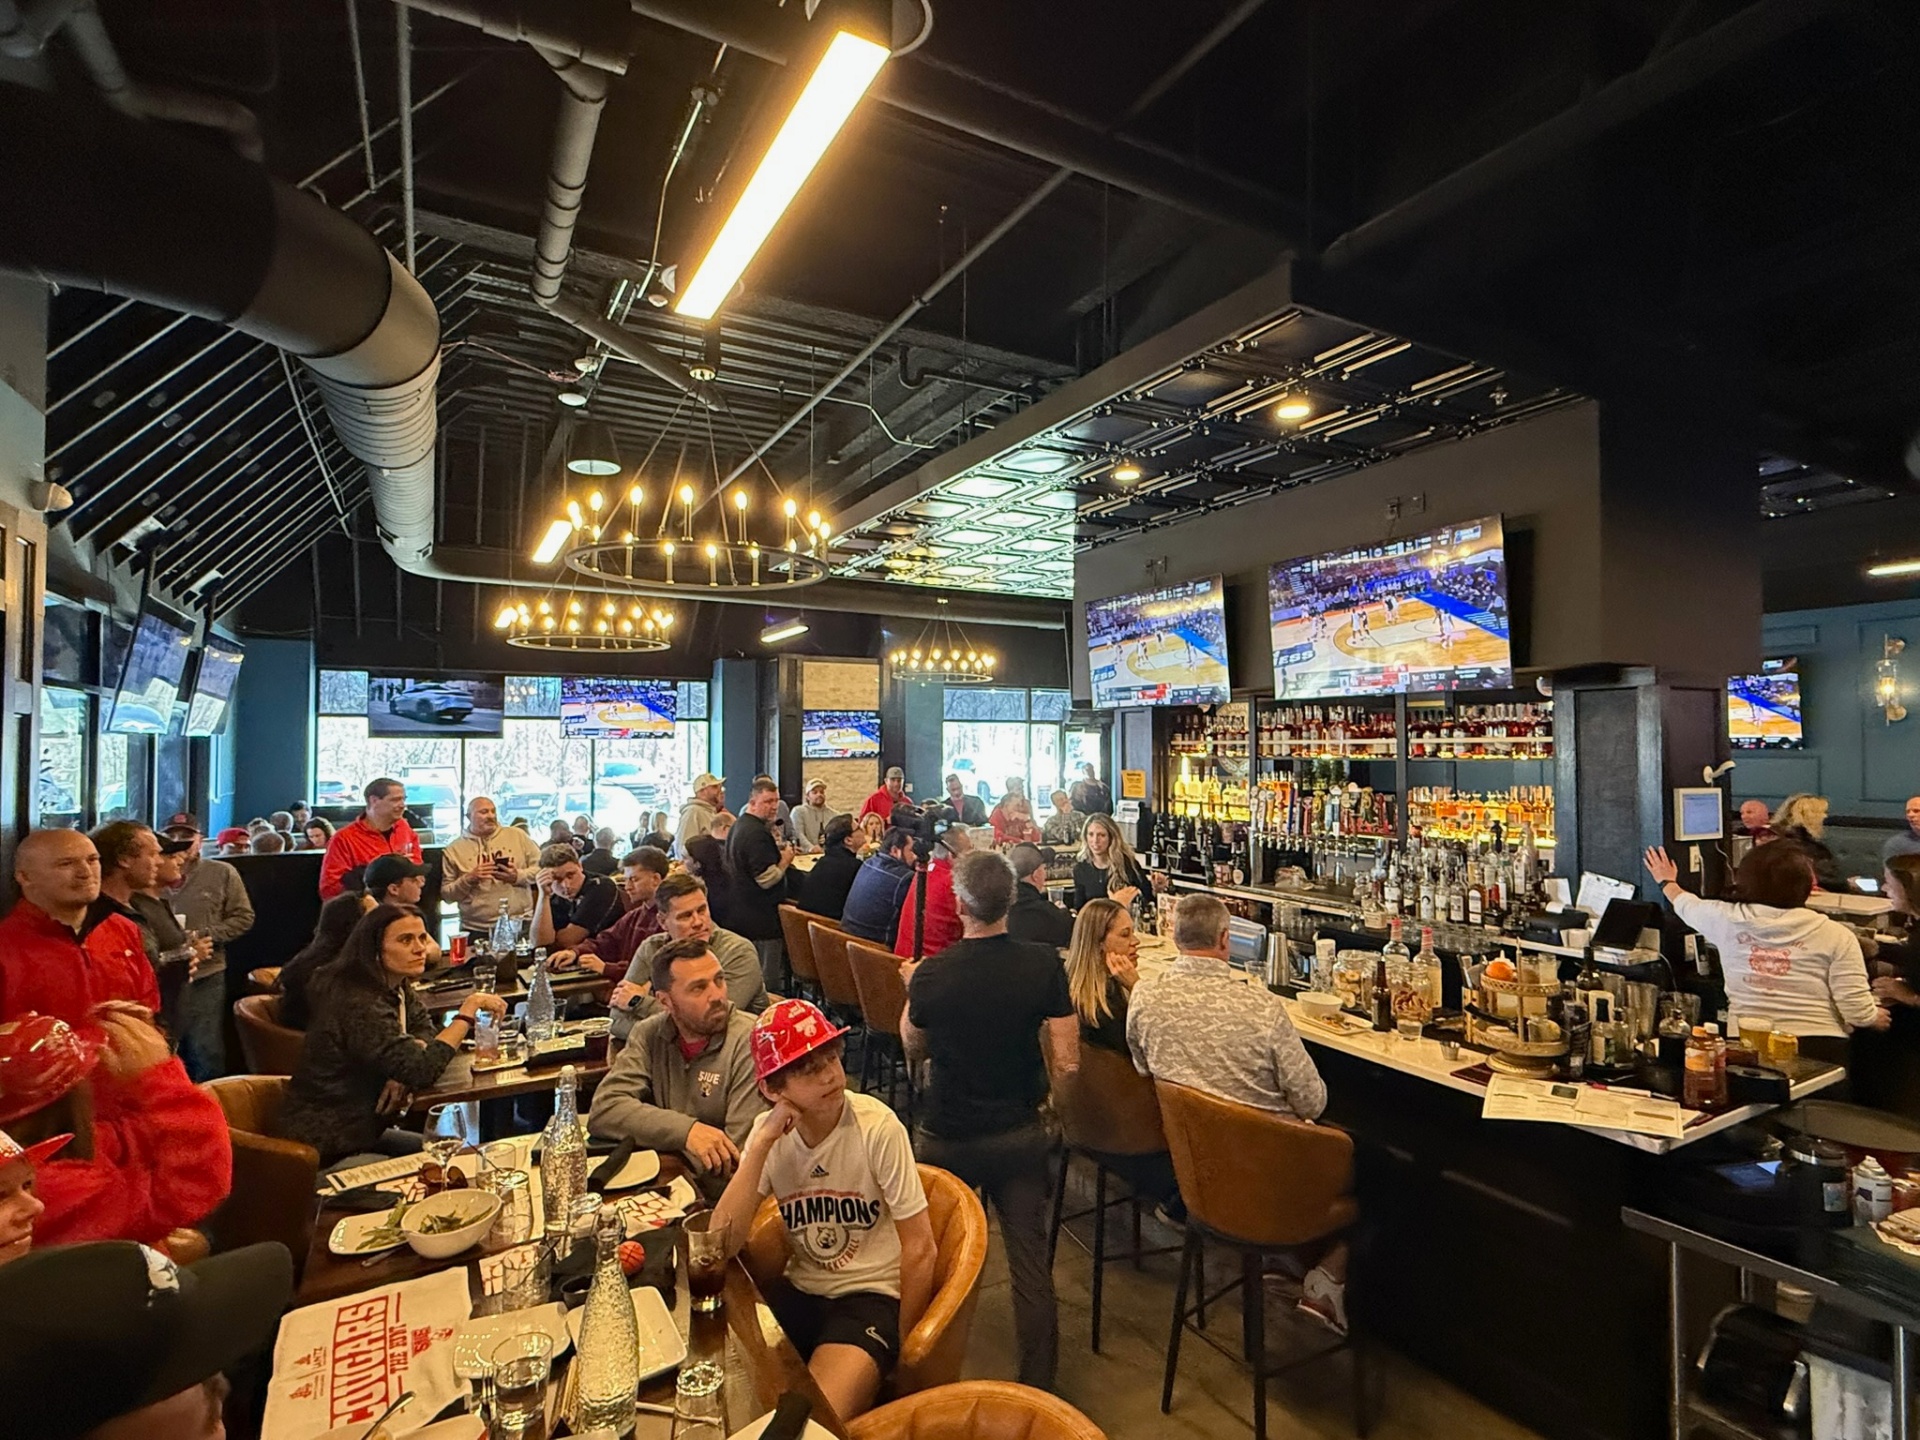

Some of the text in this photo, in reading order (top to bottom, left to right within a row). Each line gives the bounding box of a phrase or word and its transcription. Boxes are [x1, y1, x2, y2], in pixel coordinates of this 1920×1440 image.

[698, 1071, 720, 1085] SIUE
[780, 1195, 880, 1230] HAMPIONS
[331, 1297, 389, 1427] COUGARS
[389, 1324, 409, 1374] THE HUNT
